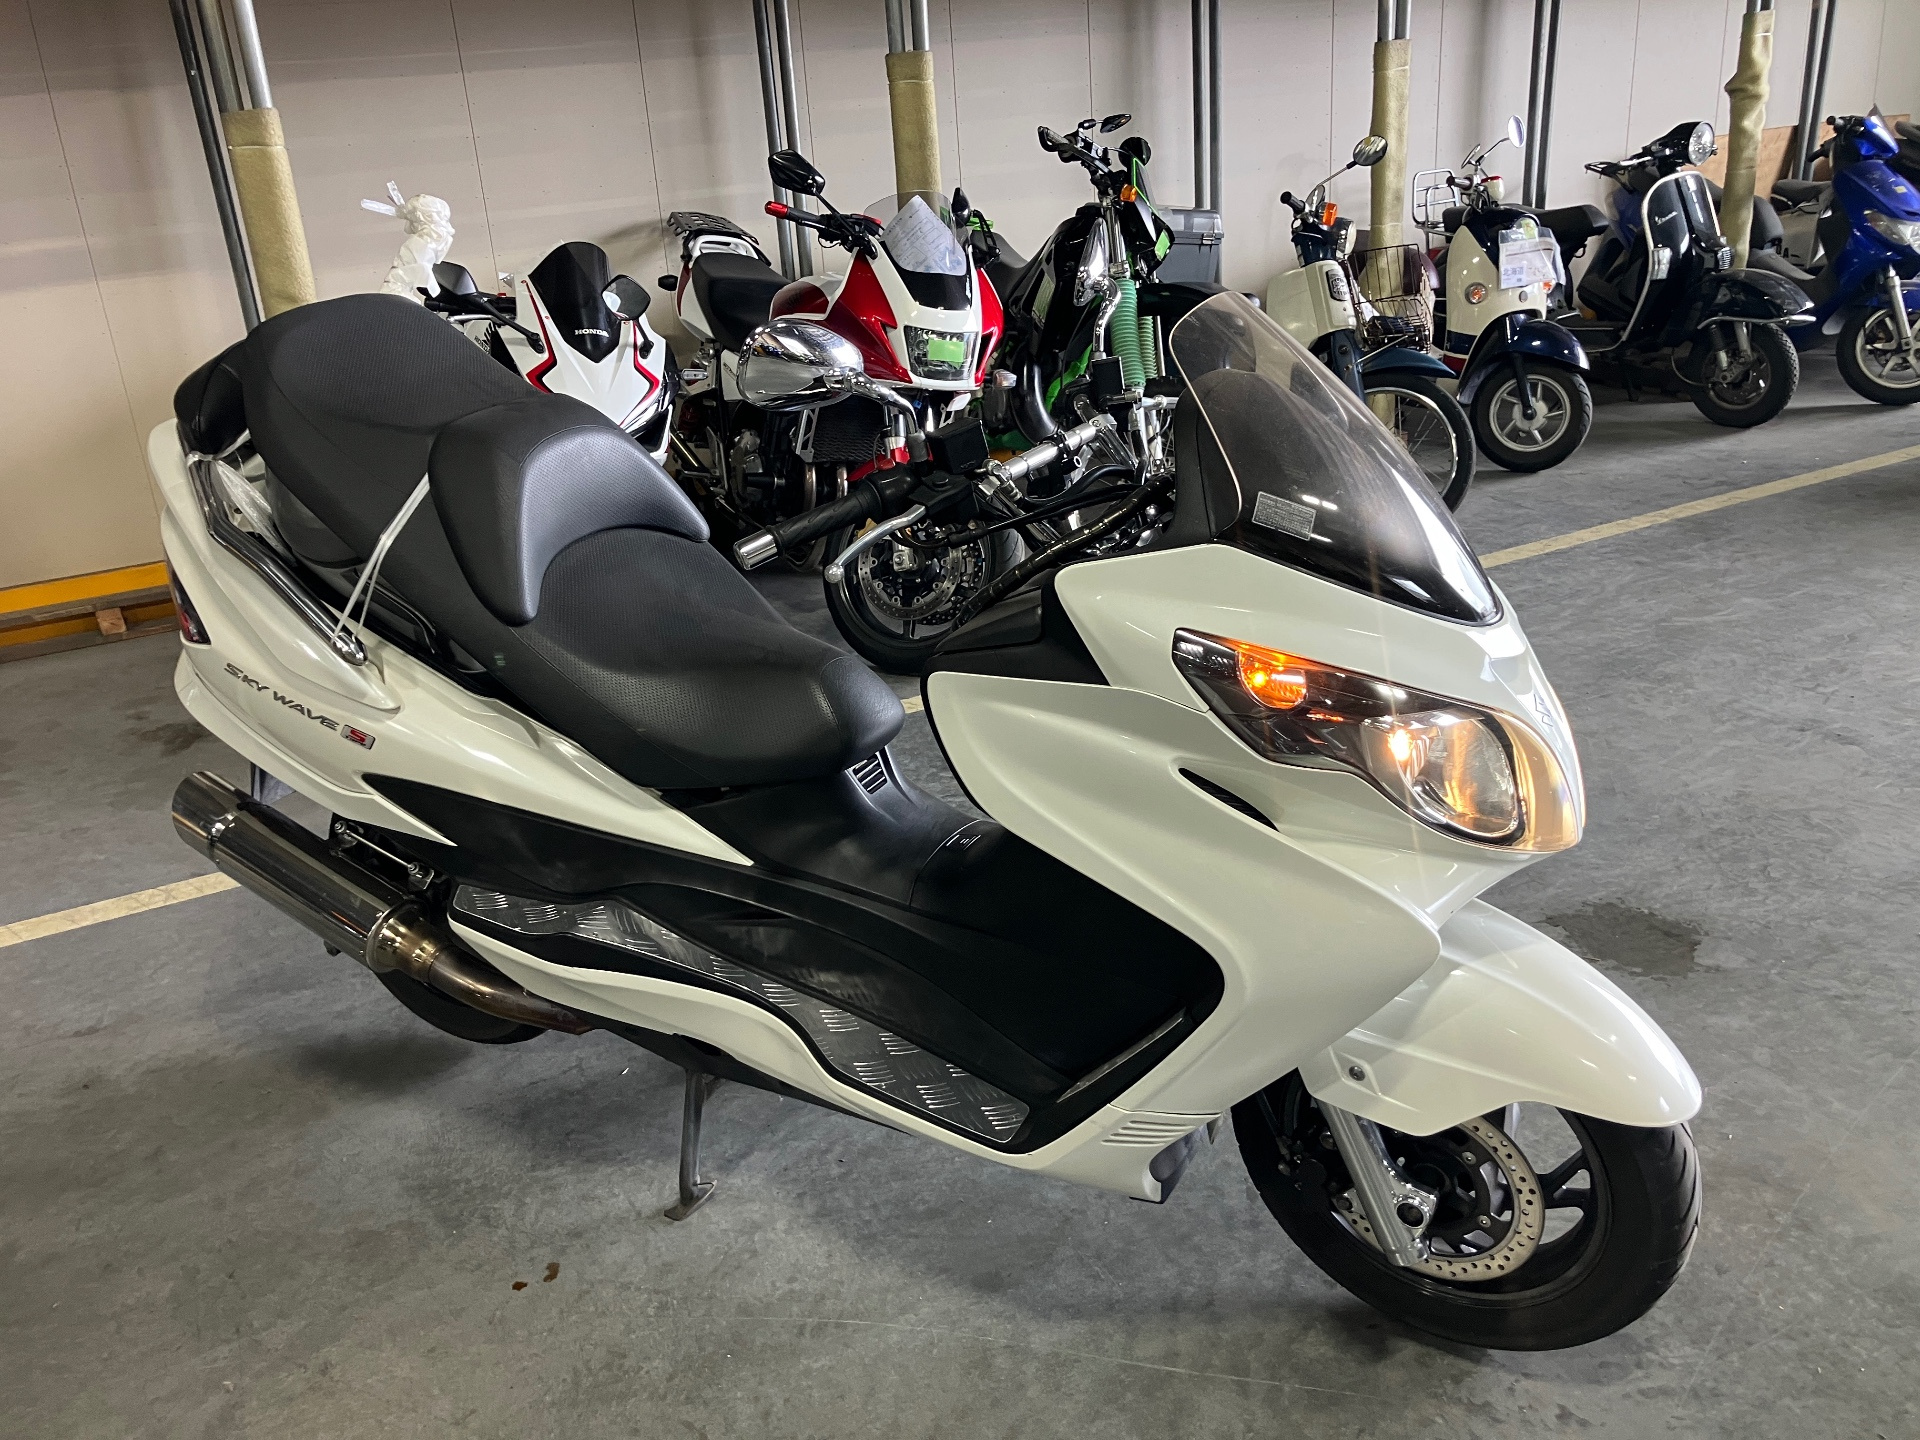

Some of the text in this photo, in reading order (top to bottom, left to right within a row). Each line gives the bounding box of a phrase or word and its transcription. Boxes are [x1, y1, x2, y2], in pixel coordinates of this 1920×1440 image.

[574, 328, 609, 338] HONDA
[224, 662, 270, 692] SKY
[273, 690, 340, 731] WAVE
